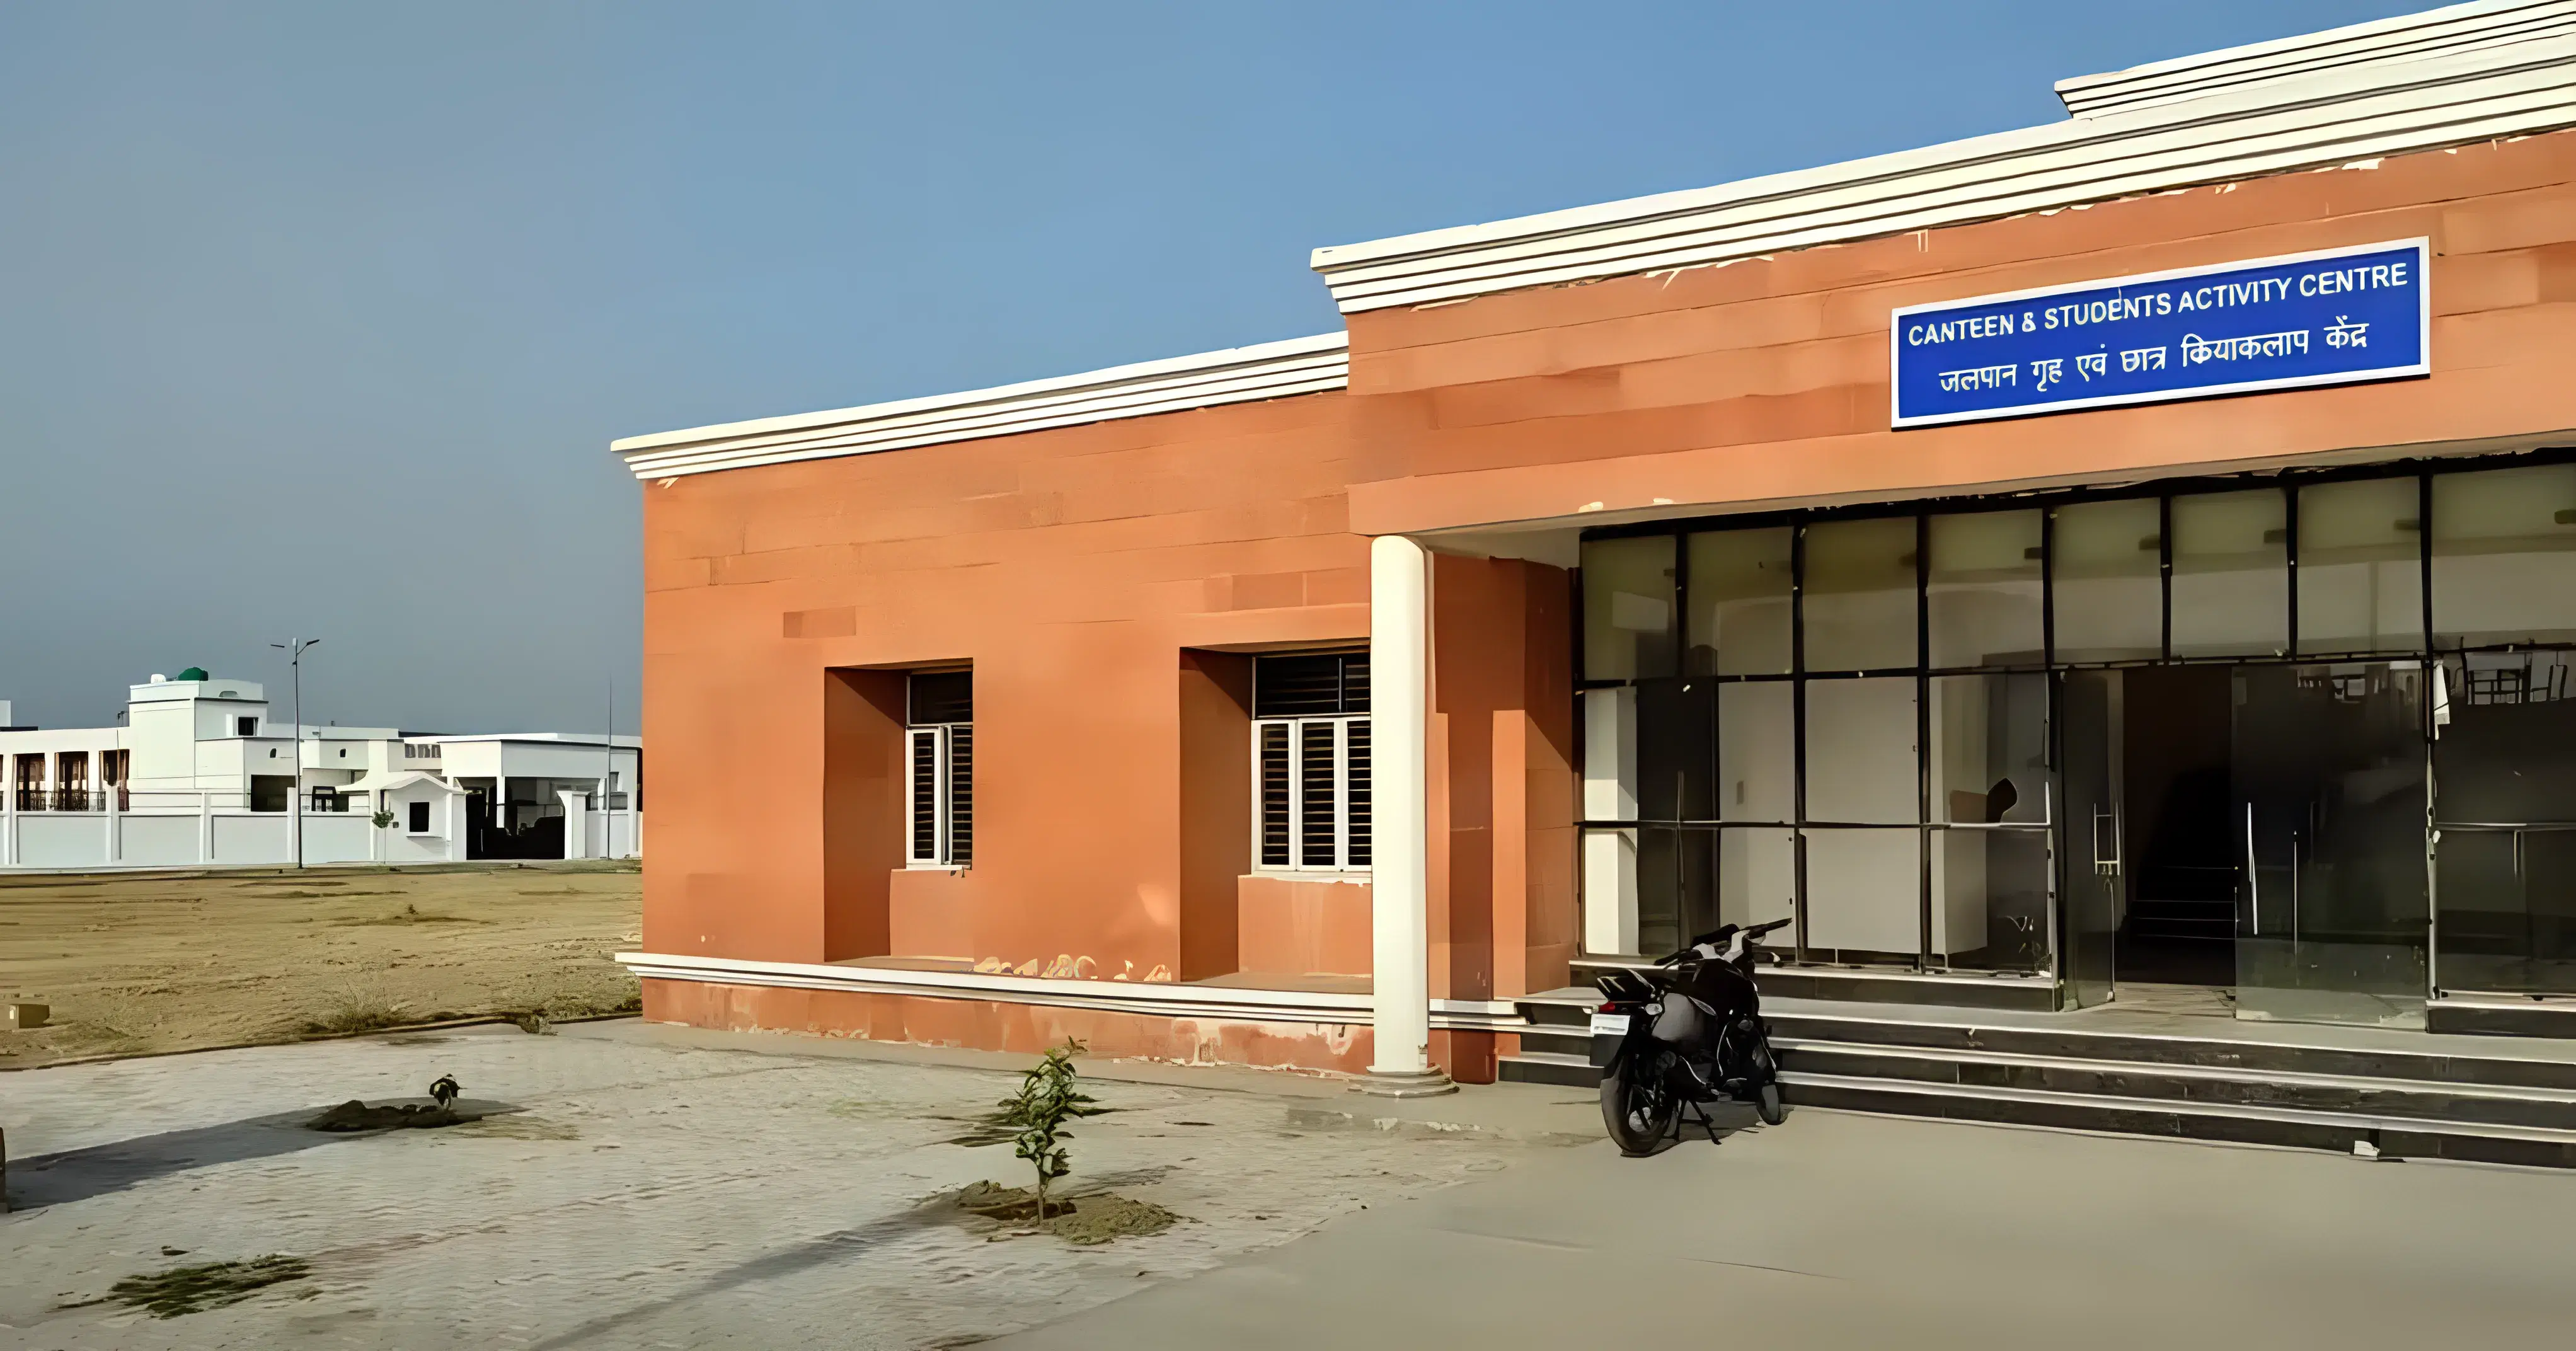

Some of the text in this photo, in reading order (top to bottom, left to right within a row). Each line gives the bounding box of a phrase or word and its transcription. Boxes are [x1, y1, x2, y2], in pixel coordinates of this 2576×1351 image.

[1908, 263, 2408, 346] CANTEEN & STUDENTS ACTIVITY CENTRE
[1938, 364, 2018, 393] जलपान
[2030, 359, 2064, 392] गृह
[2075, 343, 2108, 382] एवं
[2119, 346, 2167, 372] छात्र
[2323, 314, 2370, 349] केंद्र
